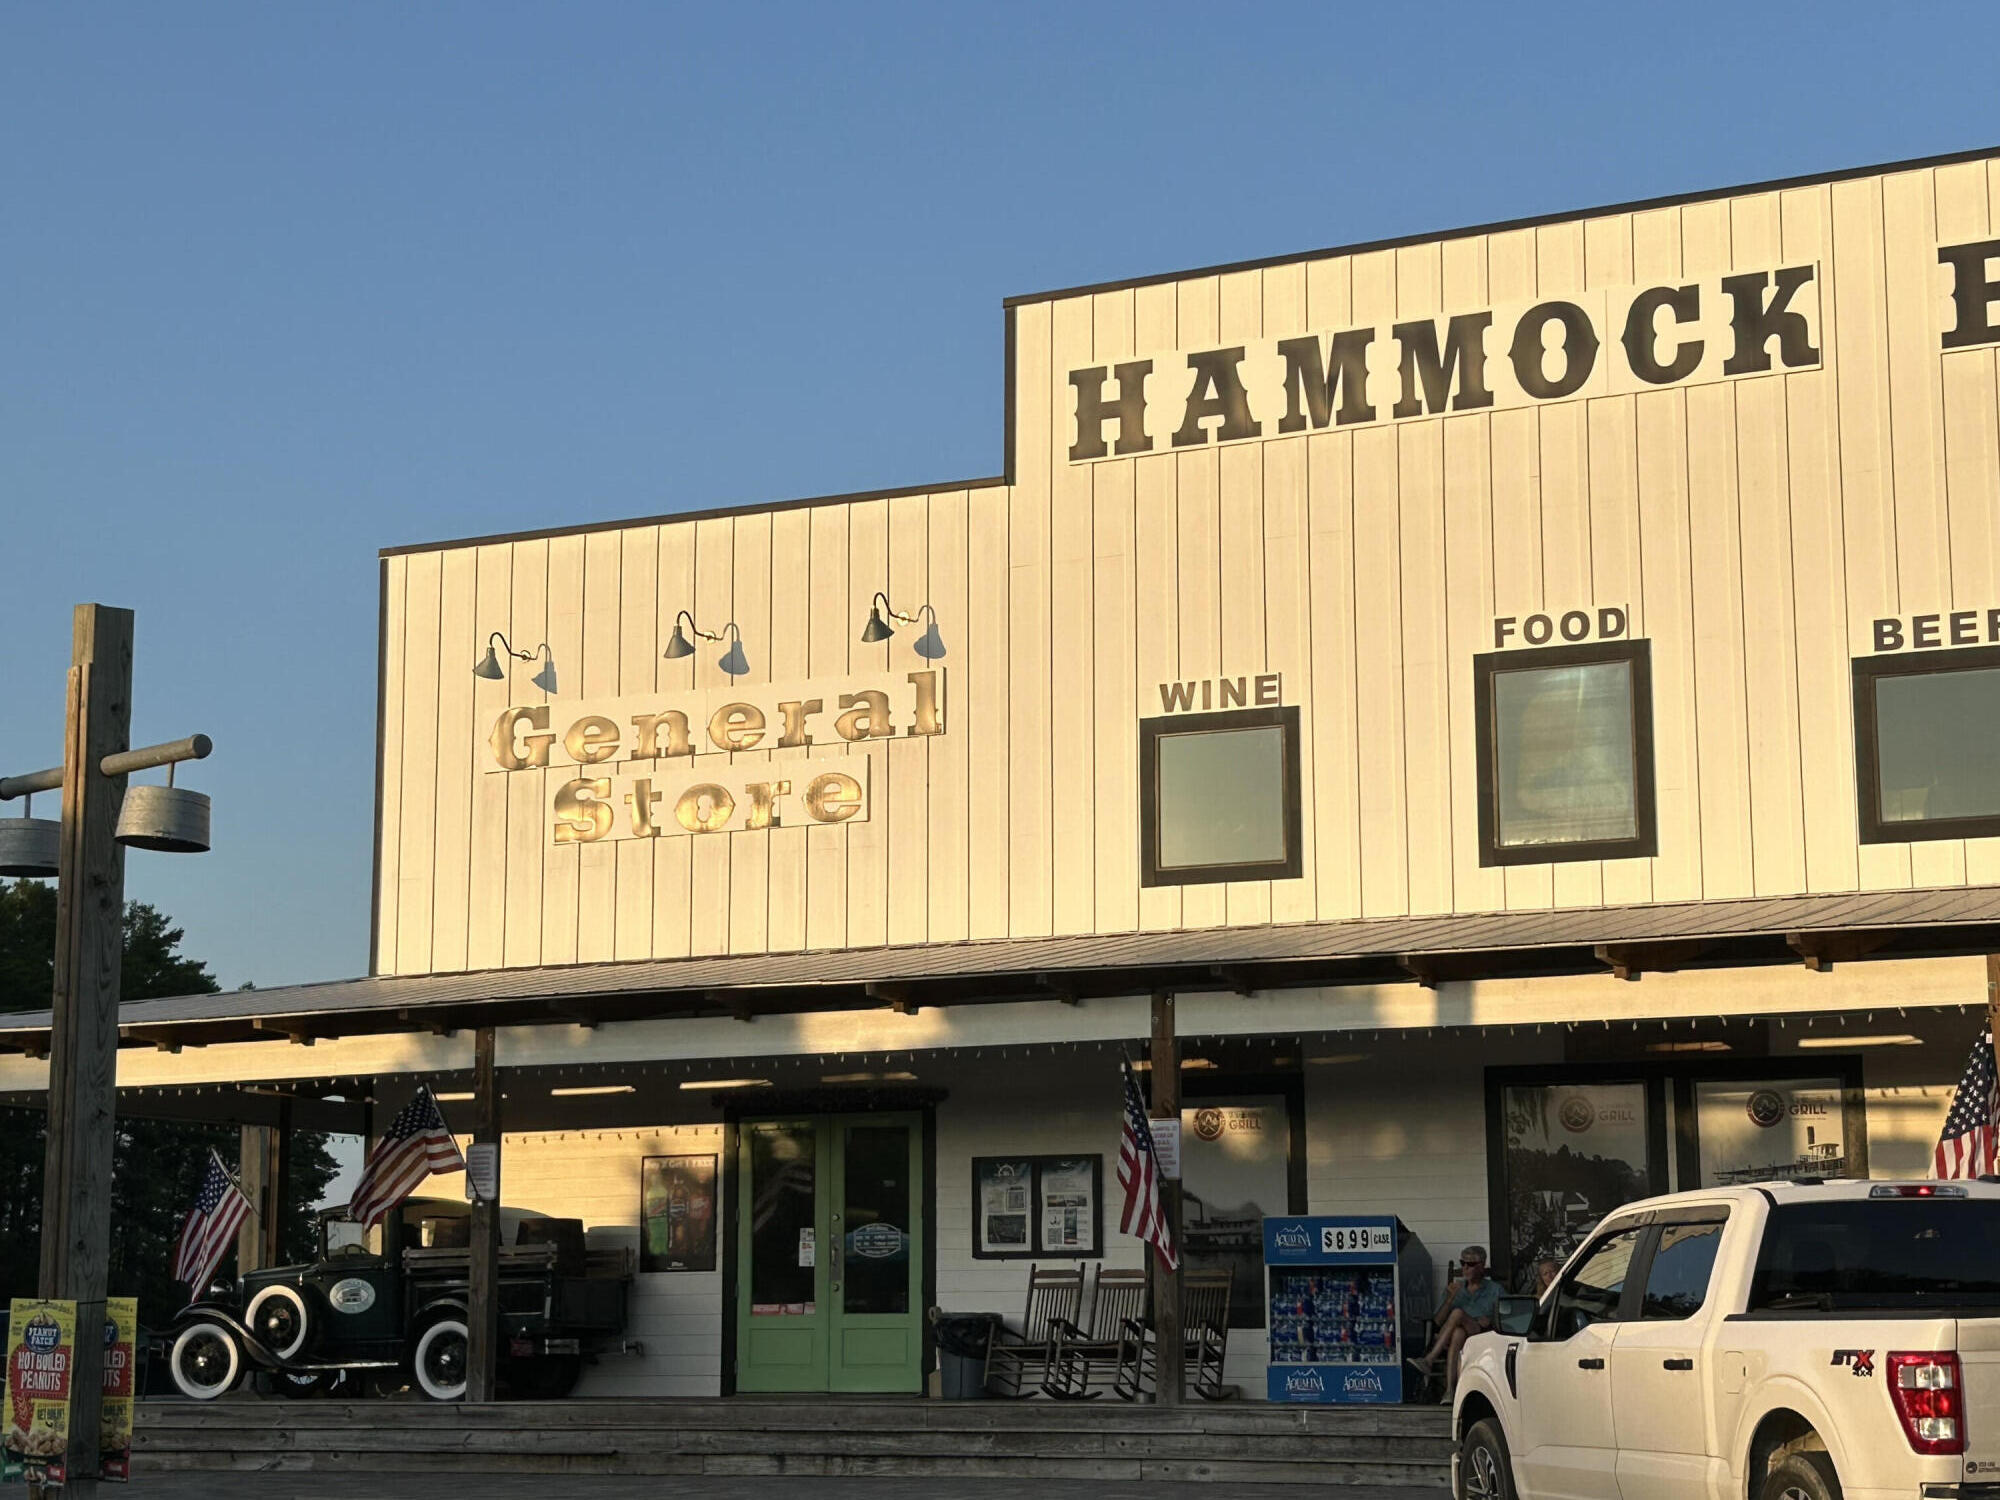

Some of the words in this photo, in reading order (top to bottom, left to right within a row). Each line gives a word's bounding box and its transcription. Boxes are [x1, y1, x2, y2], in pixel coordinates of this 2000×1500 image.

[1068, 264, 1821, 462] HAMMOCK
[1494, 607, 1628, 648] FOOD
[1159, 674, 1280, 714] WINE
[487, 670, 941, 770] General
[554, 772, 863, 843] Store
[1599, 1110, 1635, 1121] GRILL
[1789, 1103, 1828, 1116] GRILL
[1229, 1118, 1262, 1130] GRILL
[1324, 1229, 1369, 1250] $8.99
[1373, 1233, 1390, 1245] CASE
[28, 1327, 57, 1338] PEANUT
[31, 1336, 55, 1346] PATCH
[18, 1351, 36, 1370] HOT
[36, 1353, 65, 1371] BOILED
[1830, 1349, 1875, 1370] STX
[20, 1370, 61, 1390] PEANUTS
